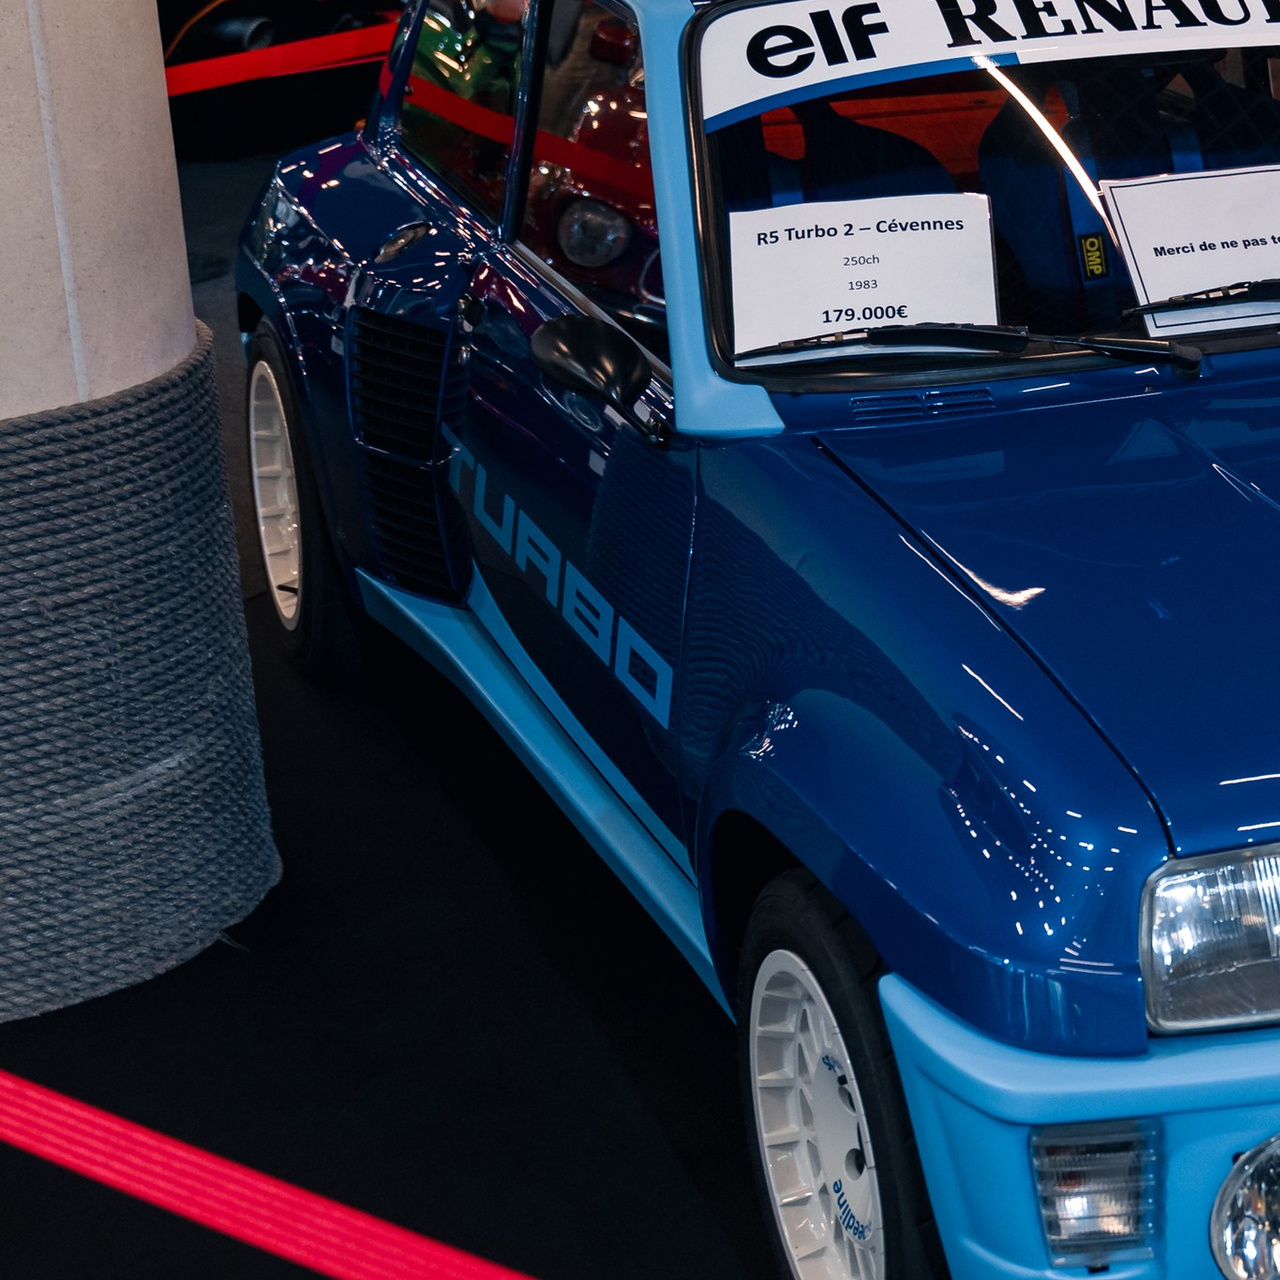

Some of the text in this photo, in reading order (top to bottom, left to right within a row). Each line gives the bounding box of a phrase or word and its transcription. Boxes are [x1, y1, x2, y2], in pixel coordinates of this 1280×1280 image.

[746, 2, 890, 78] elf
[757, 230, 779, 246] R5
[784, 224, 838, 241] Turbo
[844, 223, 854, 236] 2
[876, 219, 964, 234] Cévennes
[1086, 237, 1102, 275] OMP
[1153, 243, 1195, 257] Merci
[1200, 241, 1216, 252] de
[1221, 240, 1238, 249] ne
[1242, 236, 1268, 250] pas
[843, 254, 880, 266] 250ch
[848, 279, 878, 290] 1983
[822, 304, 908, 323] 179.000€
[441, 421, 674, 730] TURBO
